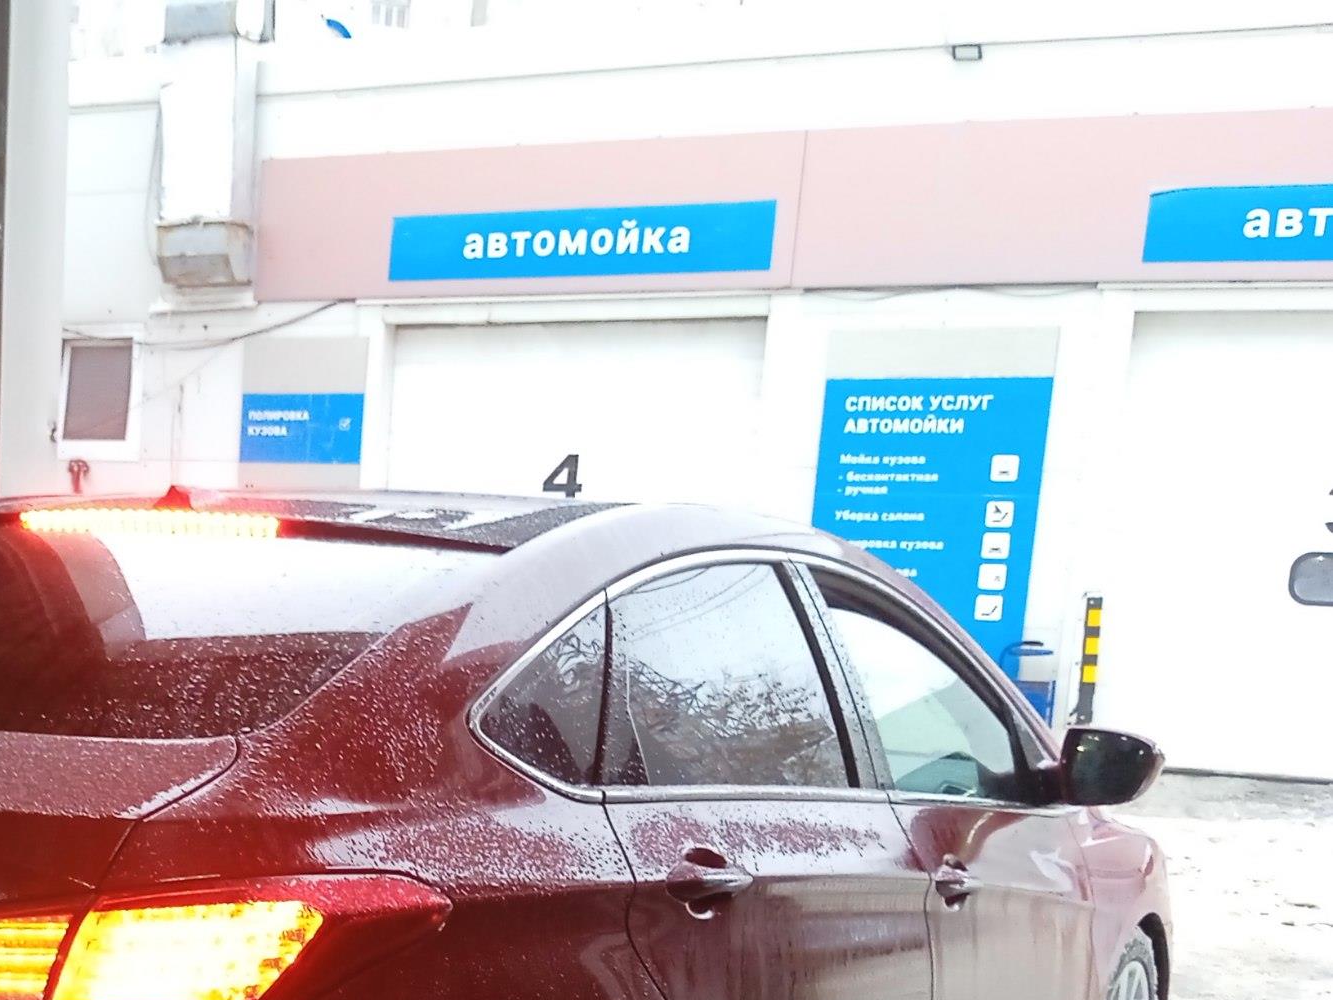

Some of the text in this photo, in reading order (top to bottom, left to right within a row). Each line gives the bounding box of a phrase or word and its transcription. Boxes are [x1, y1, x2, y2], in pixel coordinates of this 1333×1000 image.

[463, 219, 691, 260] автомойка
[845, 394, 994, 412] СПИСОК УСЛУГ
[248, 409, 310, 421] ПОЛИРОВКА
[247, 425, 287, 437] КУЗОВА
[843, 414, 965, 434] АВТОМОЙКИ
[839, 453, 926, 467] Мойка кузова
[543, 454, 582, 498] 4
[835, 509, 925, 523] Уборка салона
